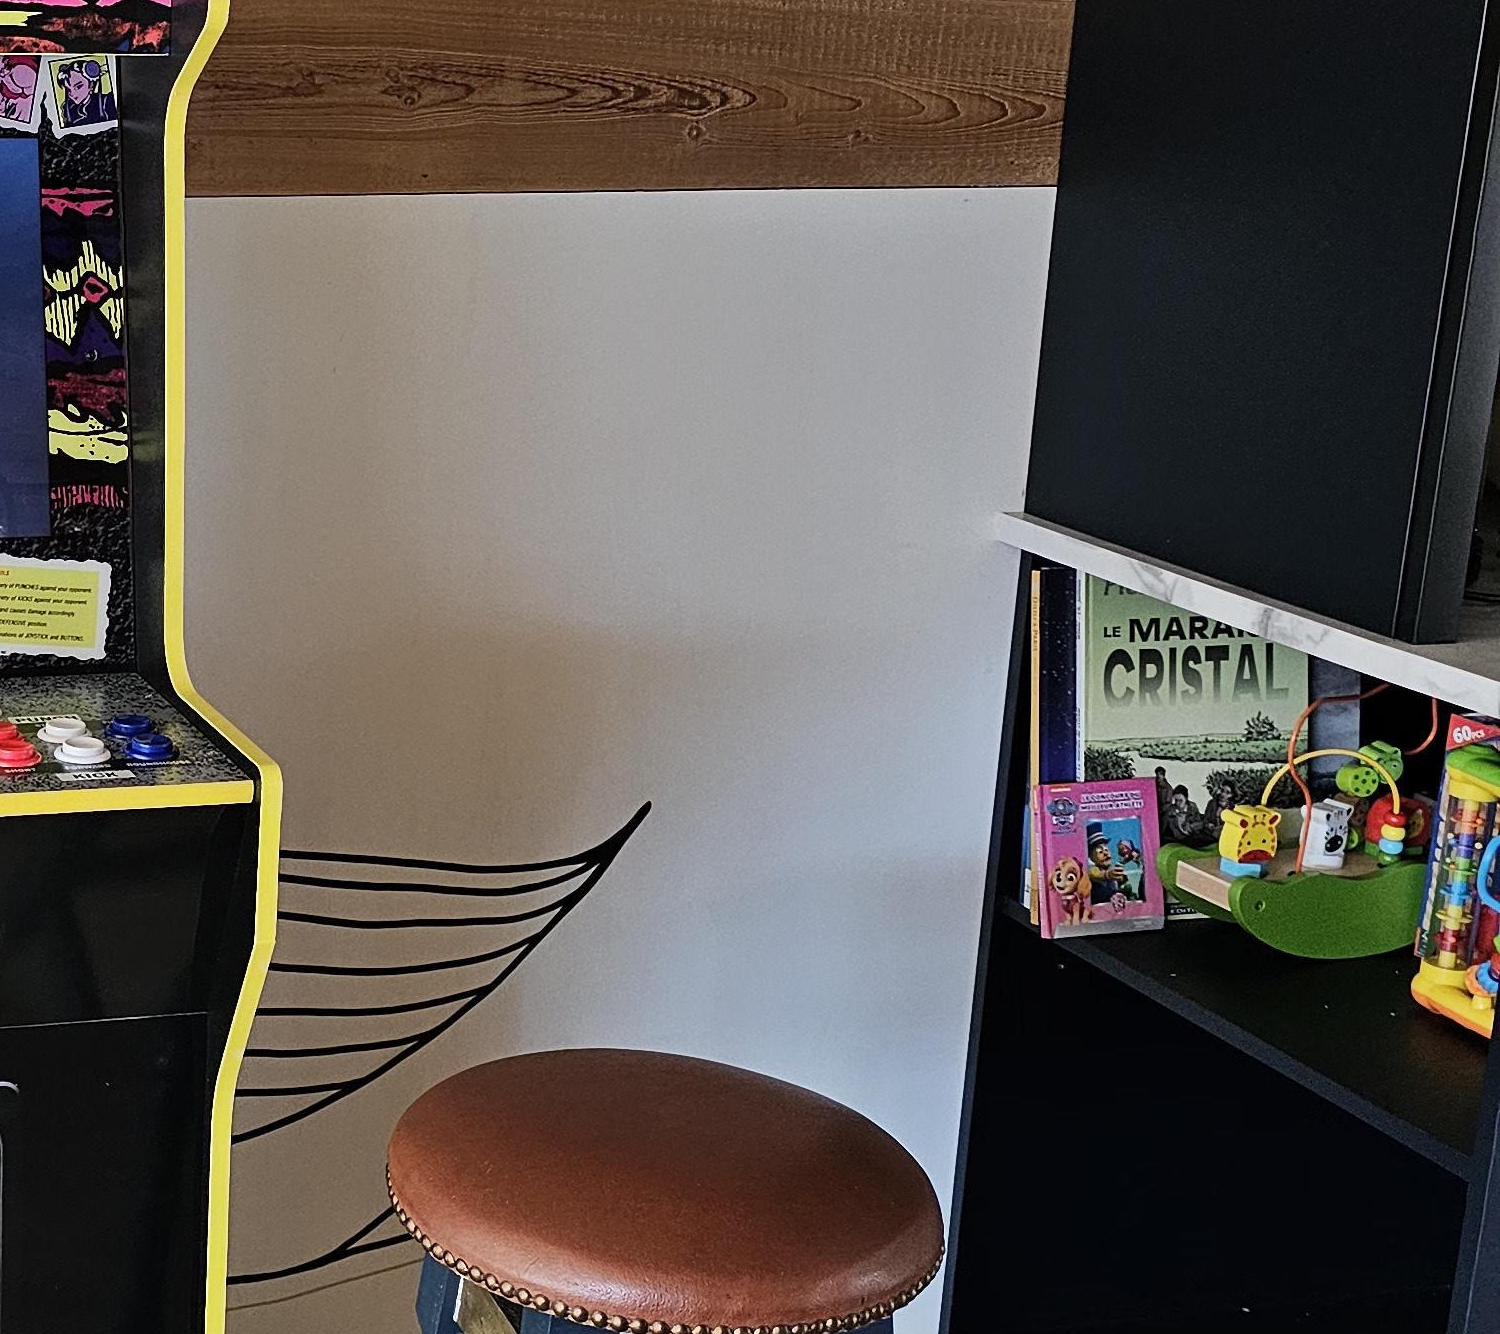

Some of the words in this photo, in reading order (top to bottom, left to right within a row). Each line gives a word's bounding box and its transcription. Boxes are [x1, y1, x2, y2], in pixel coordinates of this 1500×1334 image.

[1103, 626, 1121, 638] LE
[1129, 616, 1259, 643] MARA
[1103, 642, 1290, 709] CRISTAL
